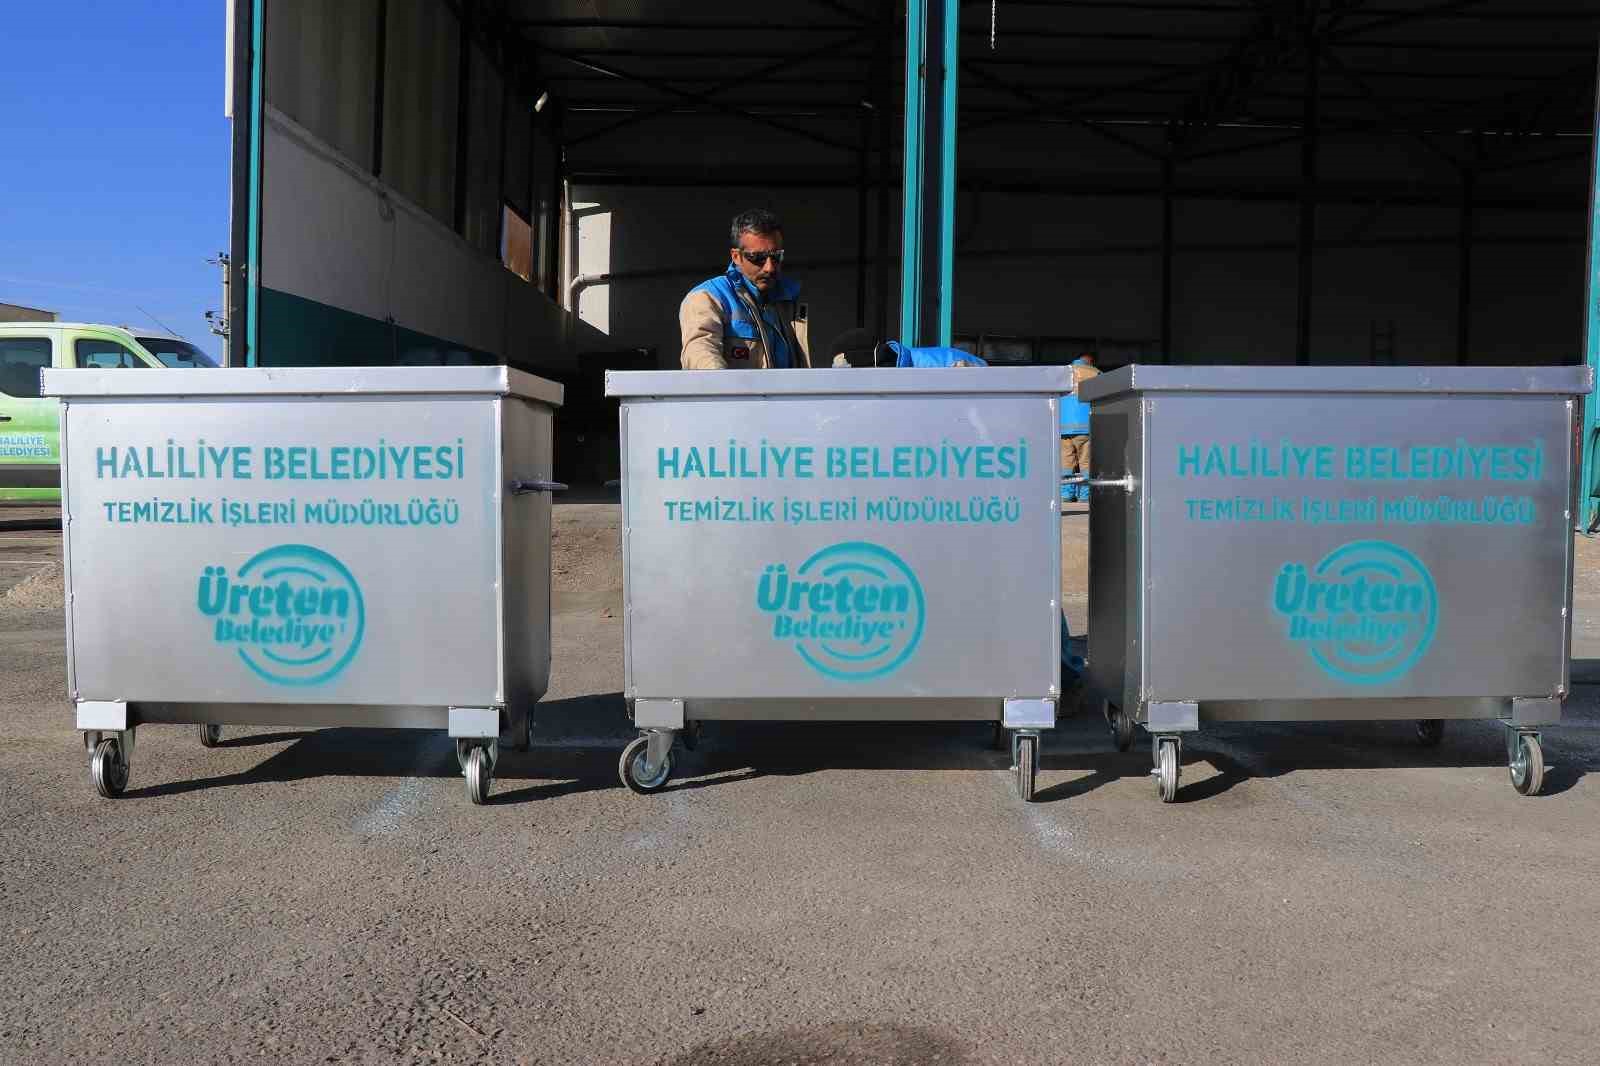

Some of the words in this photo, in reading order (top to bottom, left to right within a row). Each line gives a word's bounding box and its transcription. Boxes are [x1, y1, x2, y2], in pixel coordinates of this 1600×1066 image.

[96, 439, 253, 480] HALİLİYE
[264, 438, 464, 481] BELEDİYESİ
[657, 439, 815, 480] HALİLİYE
[825, 437, 1031, 481] BELEDİYESİ
[1175, 438, 1337, 481] HALİLİYE
[1344, 438, 1545, 481] BELEDİYESİ
[104, 498, 213, 524] TEMİZLİK
[220, 498, 297, 527] İŞLERİ
[304, 497, 460, 526] MÜDÜRLÜĞÜ
[664, 496, 775, 524] TEMİZLİK
[782, 496, 859, 525] İŞLERİ
[865, 496, 1022, 525] MÜDÜRLÜĞÜ
[1184, 497, 1296, 524] TEMİZLİK
[1301, 496, 1378, 526] İŞLERİ
[1382, 496, 1536, 526] MÜDÜRLÜĞÜ
[198, 566, 349, 617] Üreten
[758, 563, 909, 613] Üreten
[1275, 563, 1424, 613] Üreten
[215, 617, 334, 648] Belediye
[774, 615, 894, 645] Belediye
